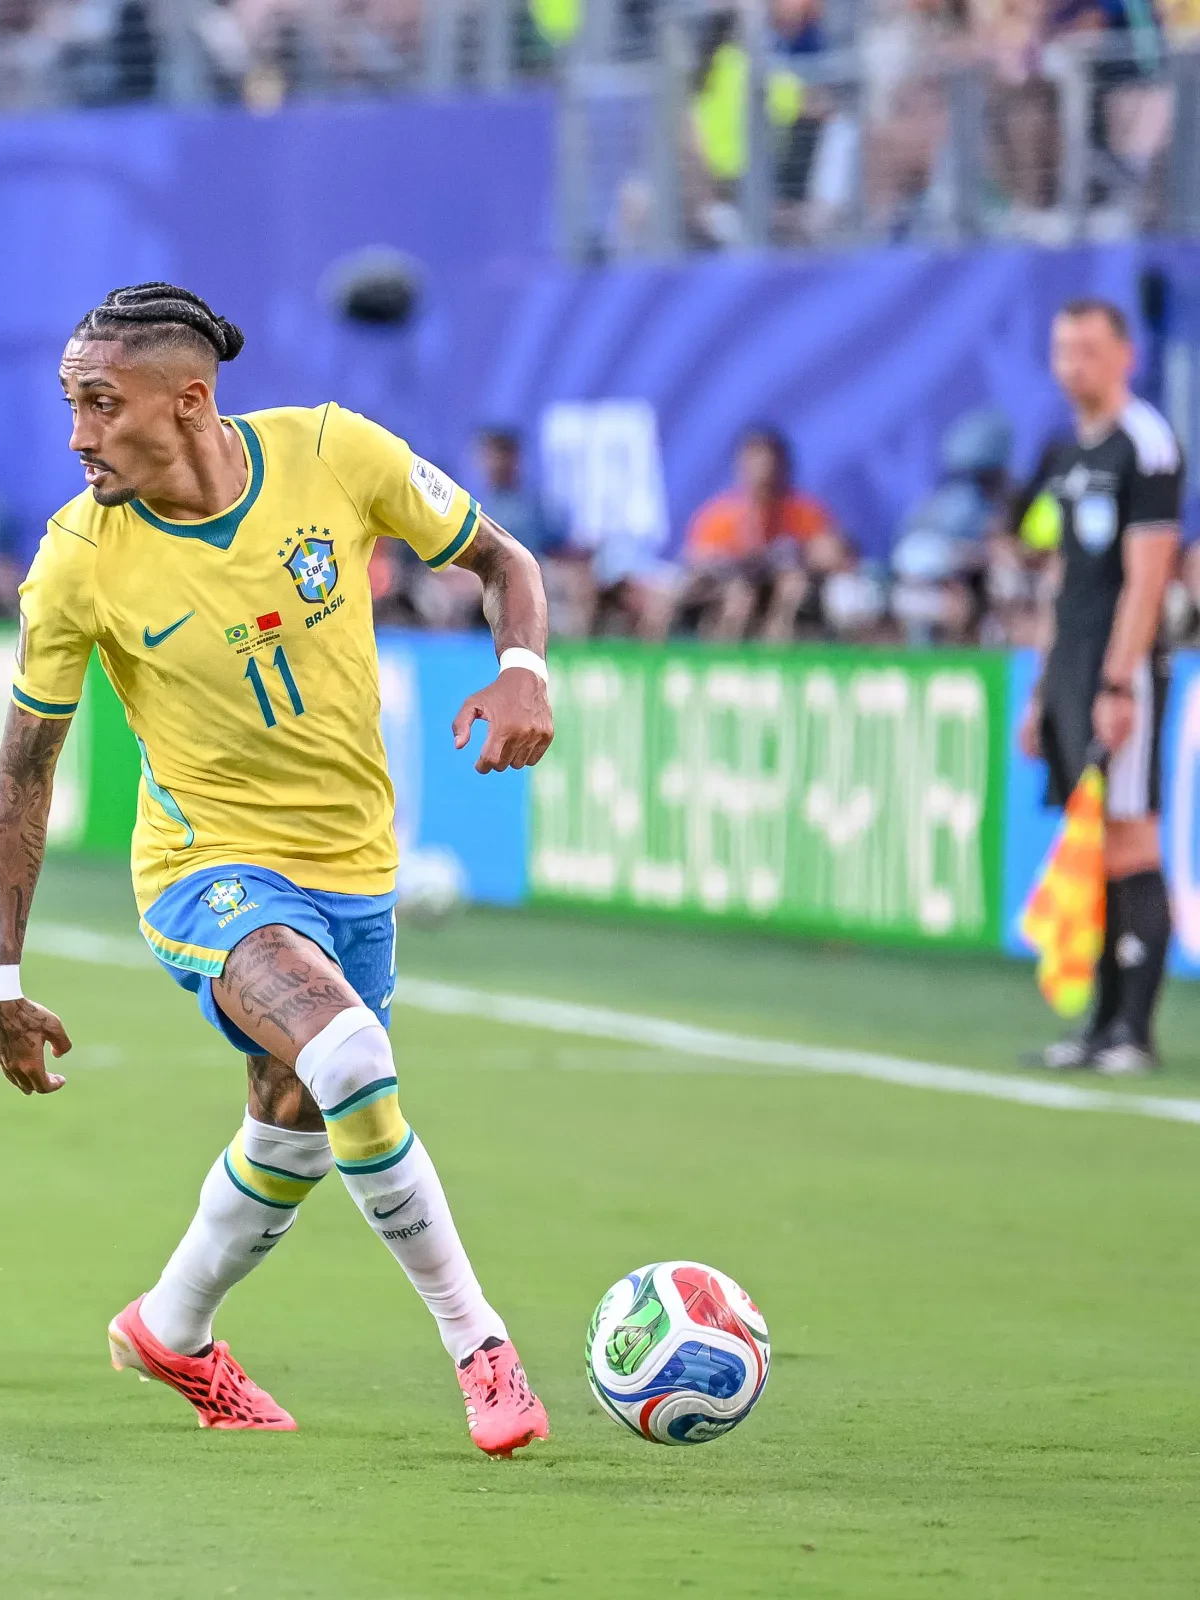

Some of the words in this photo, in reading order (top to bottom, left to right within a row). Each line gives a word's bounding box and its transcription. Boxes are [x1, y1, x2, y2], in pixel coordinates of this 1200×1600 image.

[306, 562, 324, 577] CBF
[304, 594, 346, 629] BRASIL
[242, 645, 305, 728] 11
[217, 901, 260, 928] BRASIL
[382, 1218, 433, 1240] BRASIL
